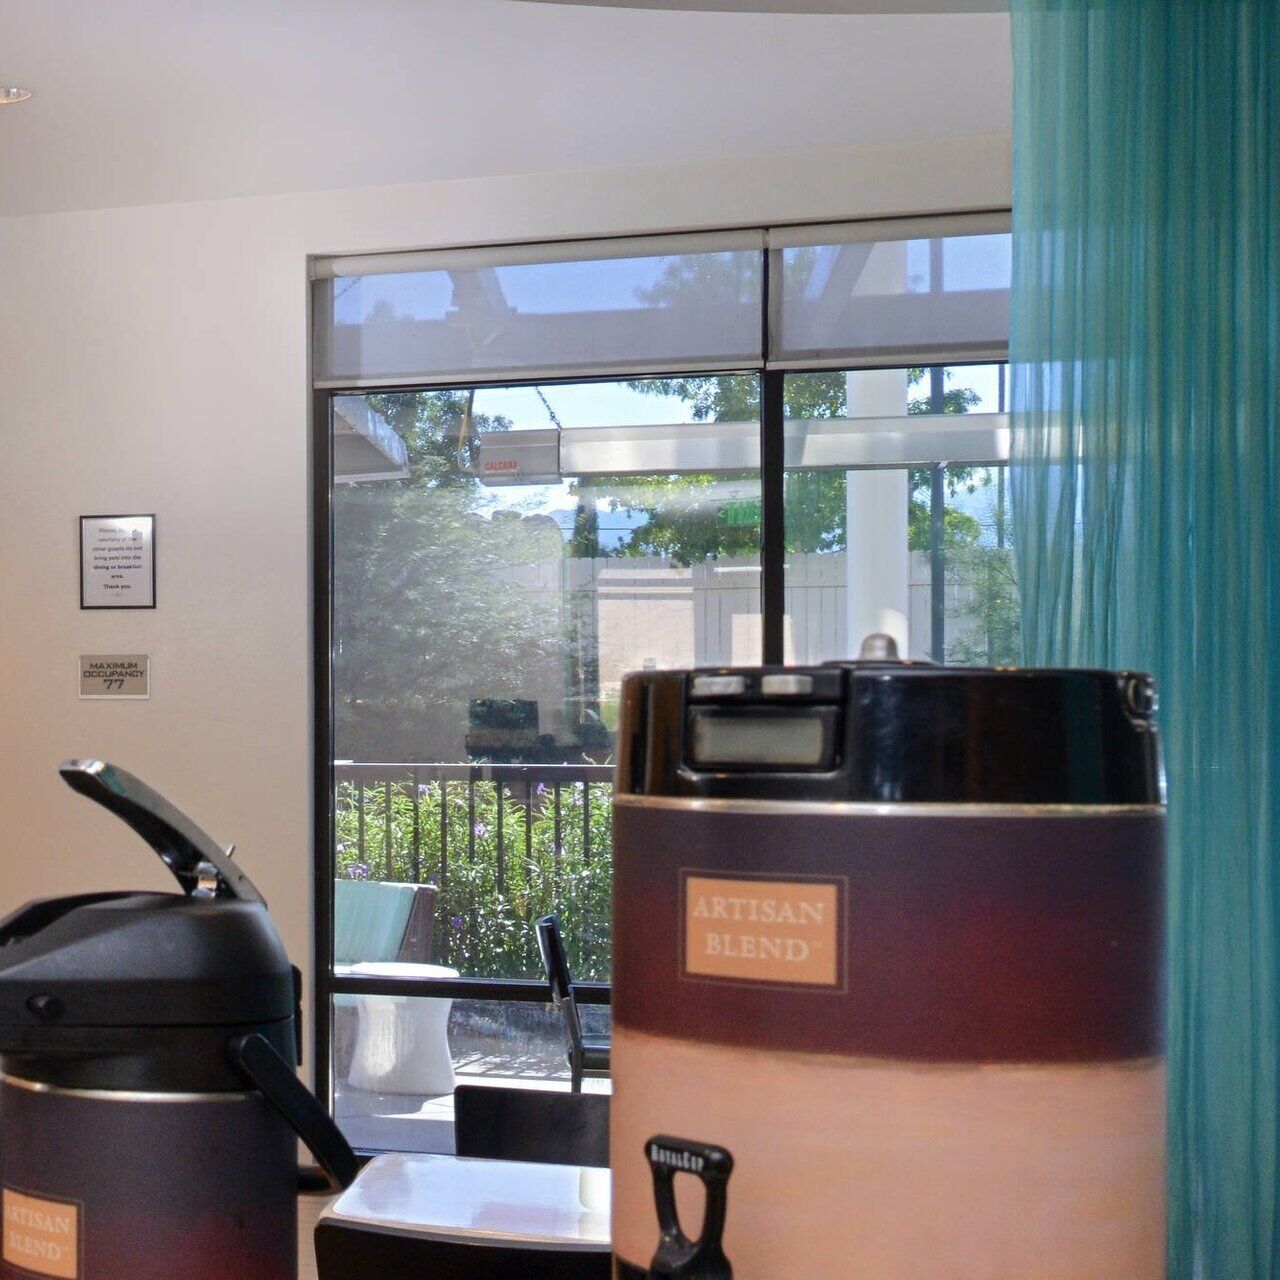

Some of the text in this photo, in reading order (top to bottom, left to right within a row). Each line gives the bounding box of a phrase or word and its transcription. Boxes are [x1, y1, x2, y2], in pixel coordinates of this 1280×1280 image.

[83, 670, 145, 678] OCCUPANCY
[103, 679, 125, 690] 77
[692, 896, 825, 927] ARTISAN
